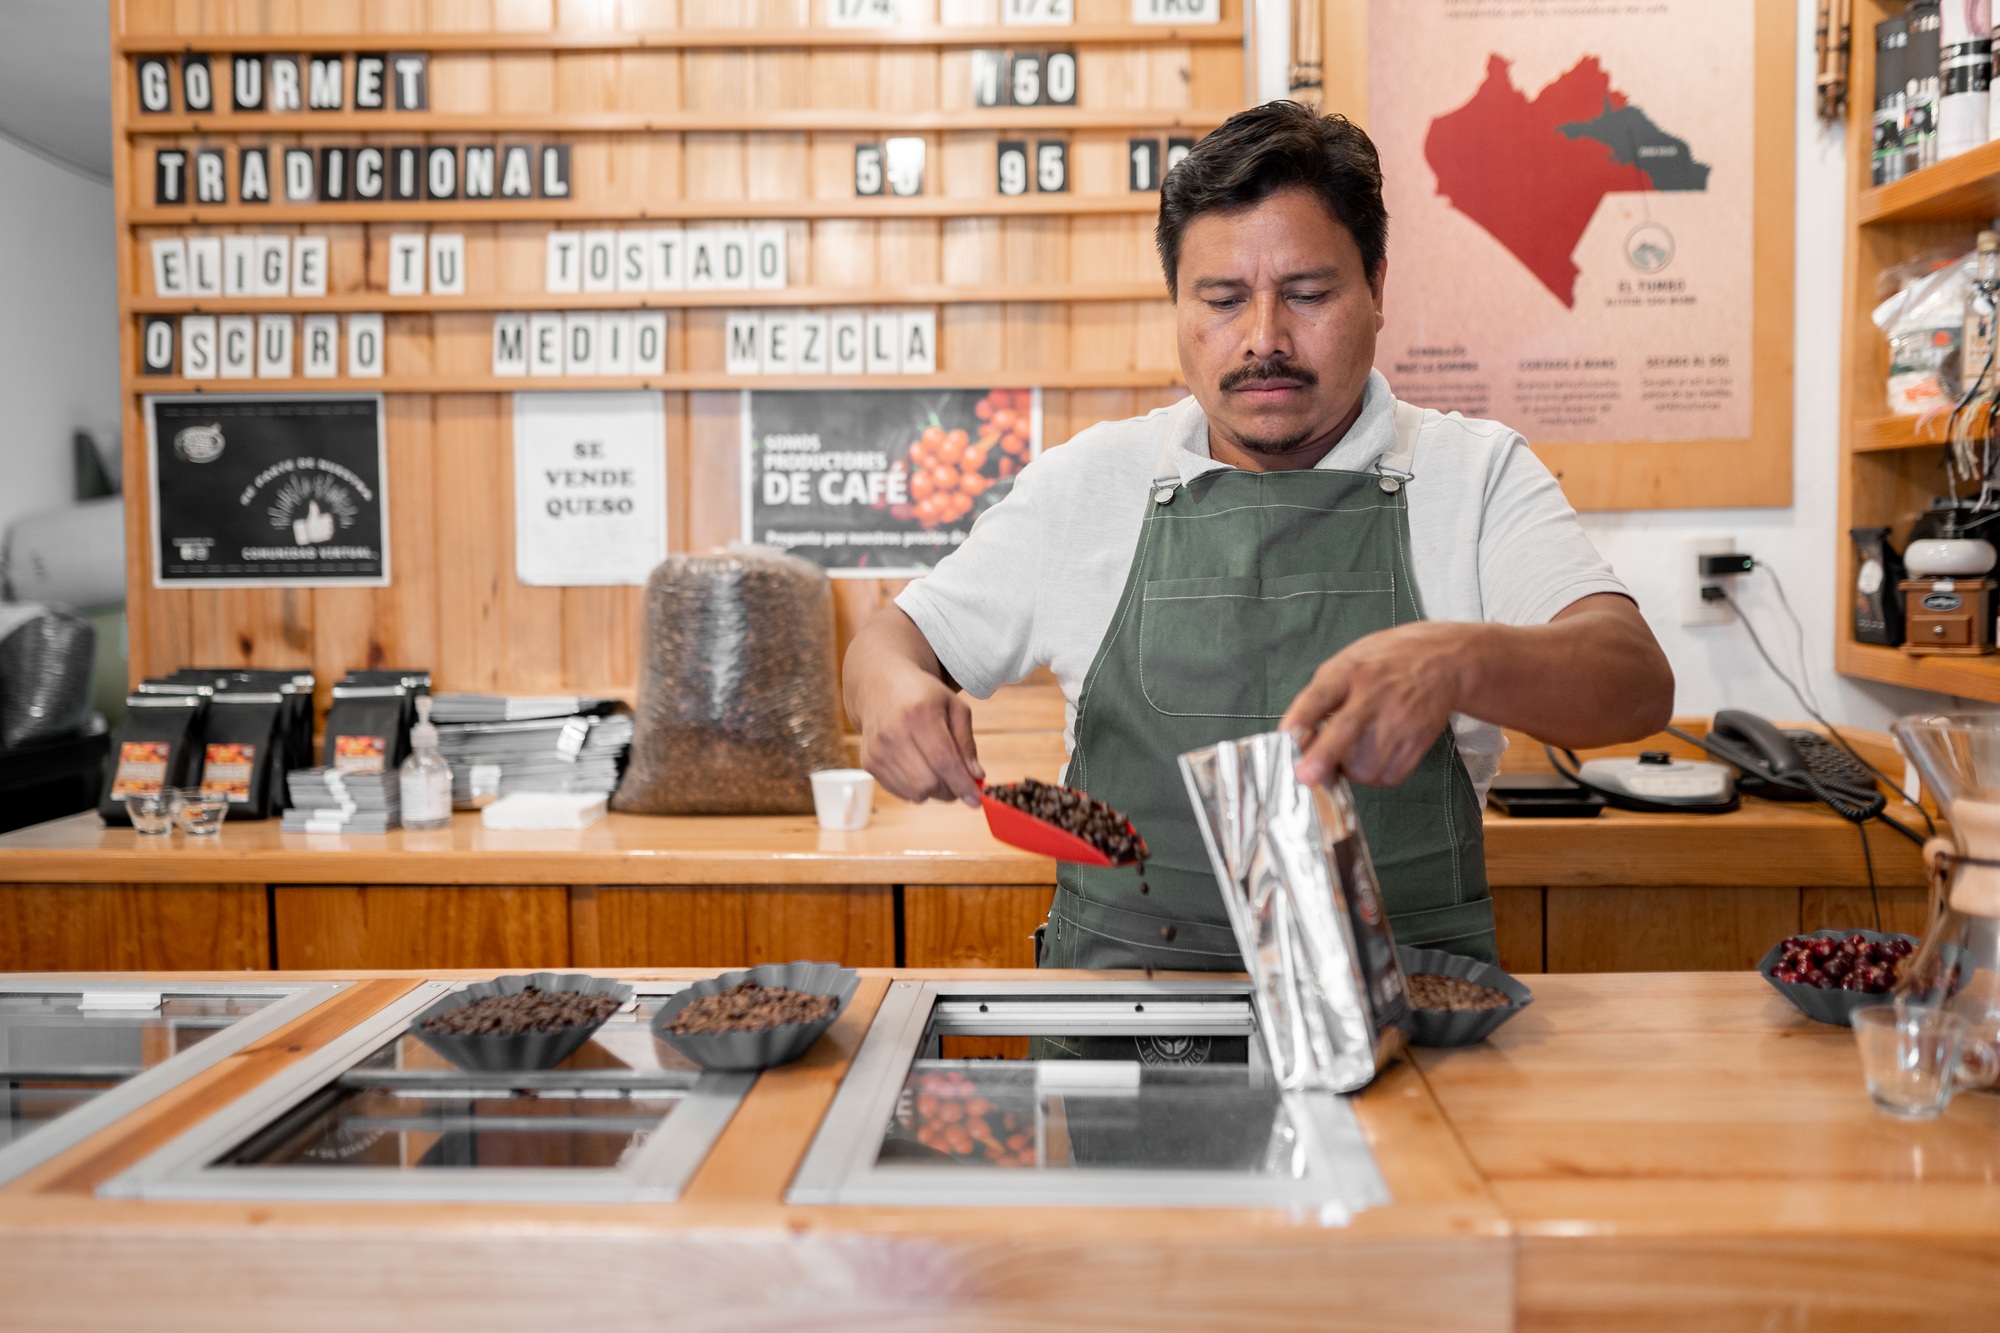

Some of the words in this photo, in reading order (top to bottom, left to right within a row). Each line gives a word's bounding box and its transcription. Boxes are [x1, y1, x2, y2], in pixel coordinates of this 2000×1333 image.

[140, 58, 423, 111] GOURMET
[977, 53, 1075, 105] 150
[160, 148, 569, 201] TRADICIONAL
[999, 146, 1065, 195] 95
[161, 248, 318, 289] ELIGE
[400, 245, 456, 286] TU
[556, 241, 778, 279] TOSTADO
[145, 317, 375, 370] OSCURO
[499, 323, 657, 366] MEDIO
[732, 323, 926, 363] MEZCLA
[573, 441, 605, 460] SE
[763, 433, 821, 451] SOMOS
[296, 456, 317, 471] DE
[545, 469, 636, 488] VENDE
[763, 452, 888, 472] PRODUCTORES
[763, 472, 811, 505] DE
[818, 460, 908, 505] CAFÉ
[546, 498, 635, 521] QUESO
[241, 546, 318, 561] COMUNIDAD
